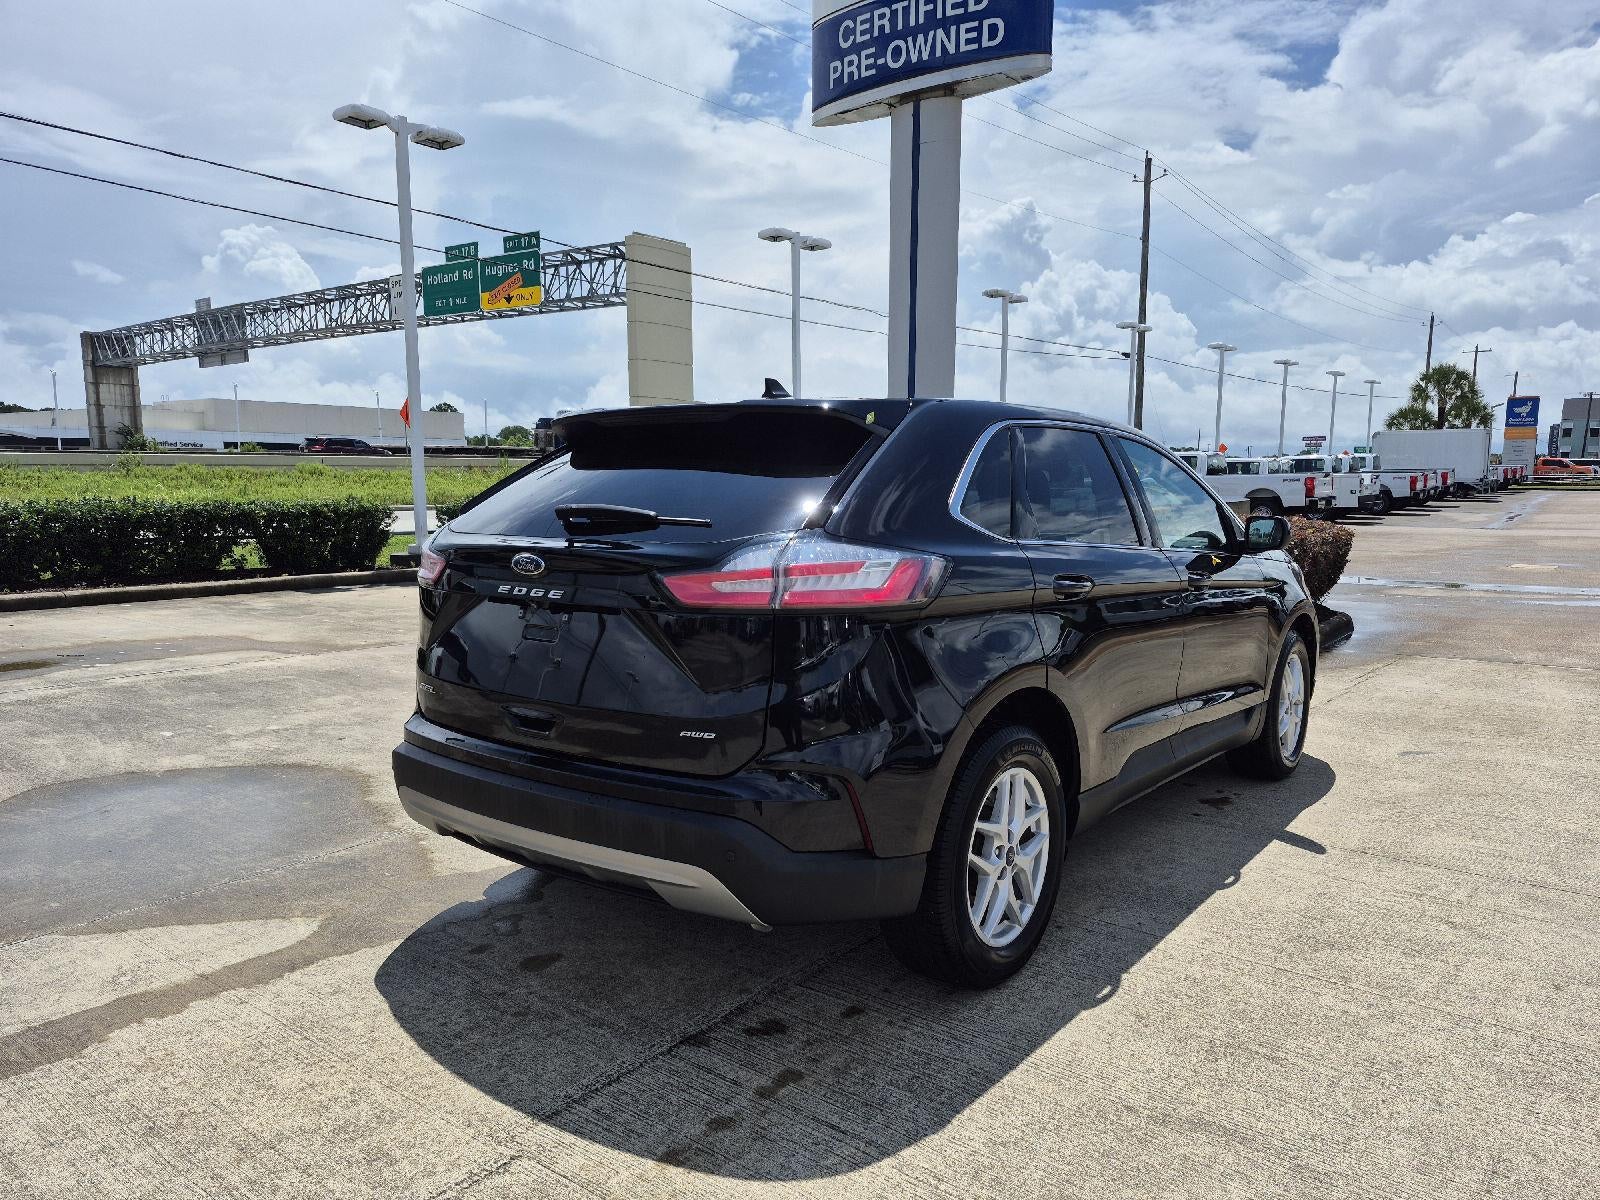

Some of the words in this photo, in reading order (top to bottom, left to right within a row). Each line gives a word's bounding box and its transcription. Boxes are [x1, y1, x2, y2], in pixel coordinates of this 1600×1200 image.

[829, 17, 1005, 89] PRE-OWNED
[506, 240, 518, 248] EXIT
[485, 262, 518, 277] Hughes
[522, 257, 535, 271] Rd
[427, 270, 459, 285] Holland
[463, 268, 473, 279] Rd
[501, 276, 521, 293] CLOSED
[455, 296, 468, 305] MILE
[515, 291, 534, 302] ONLY
[497, 585, 565, 599] EDGE
[679, 731, 716, 739] AWD
